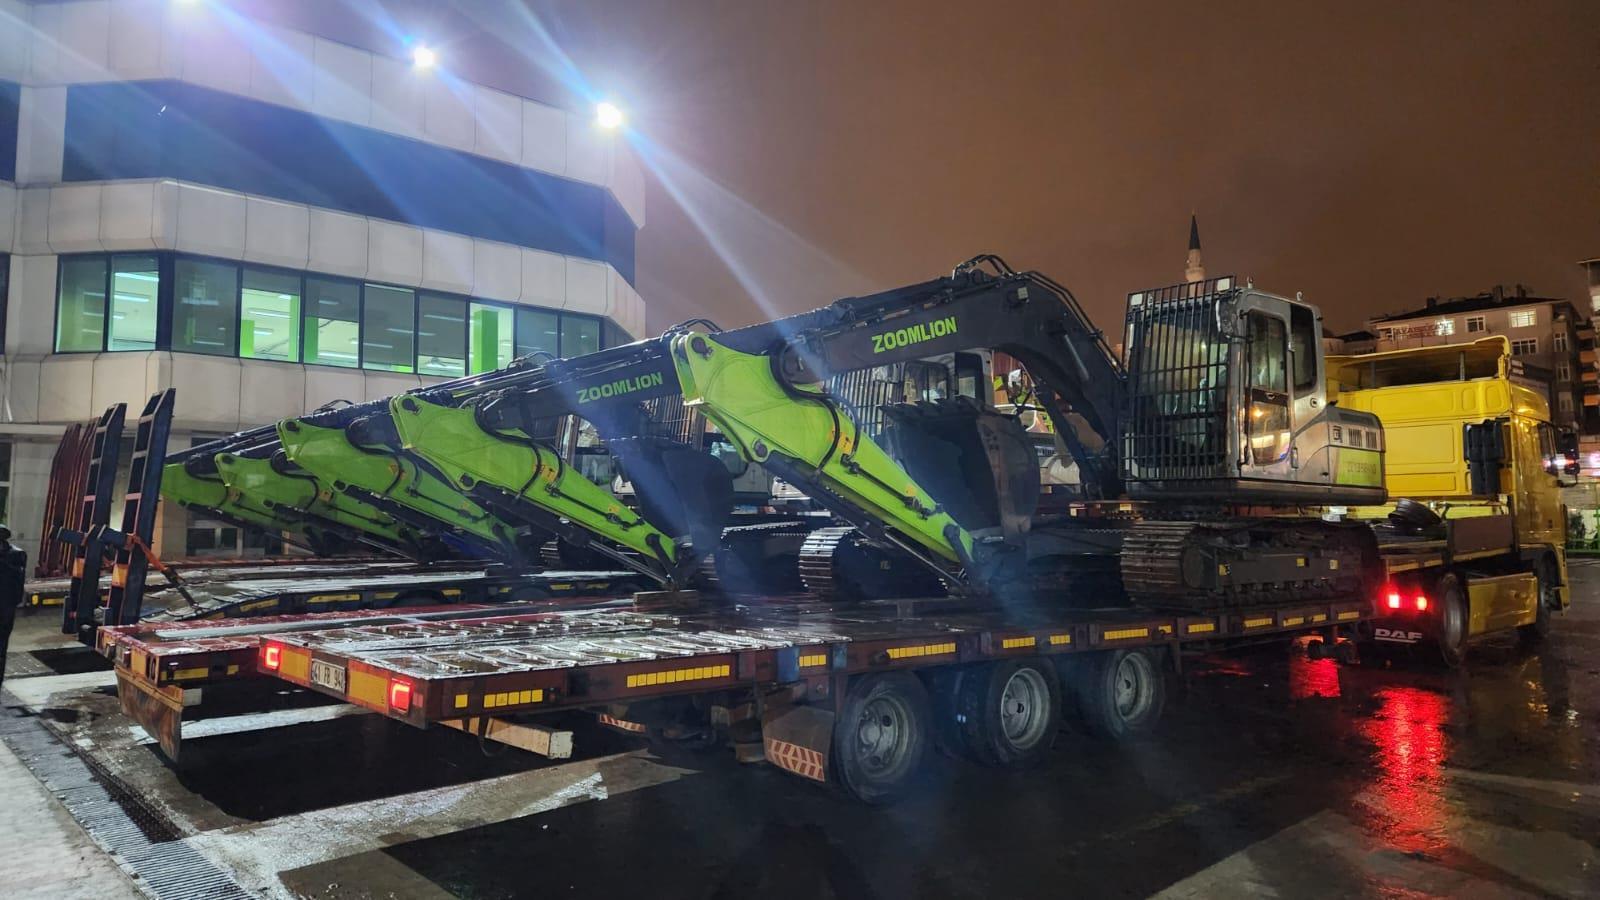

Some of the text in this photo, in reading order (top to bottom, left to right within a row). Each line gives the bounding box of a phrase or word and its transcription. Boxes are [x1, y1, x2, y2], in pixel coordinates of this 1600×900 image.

[871, 316, 958, 354] ZOOMLION
[576, 372, 663, 404] ZOOMLION
[1375, 628, 1423, 641] DAF
